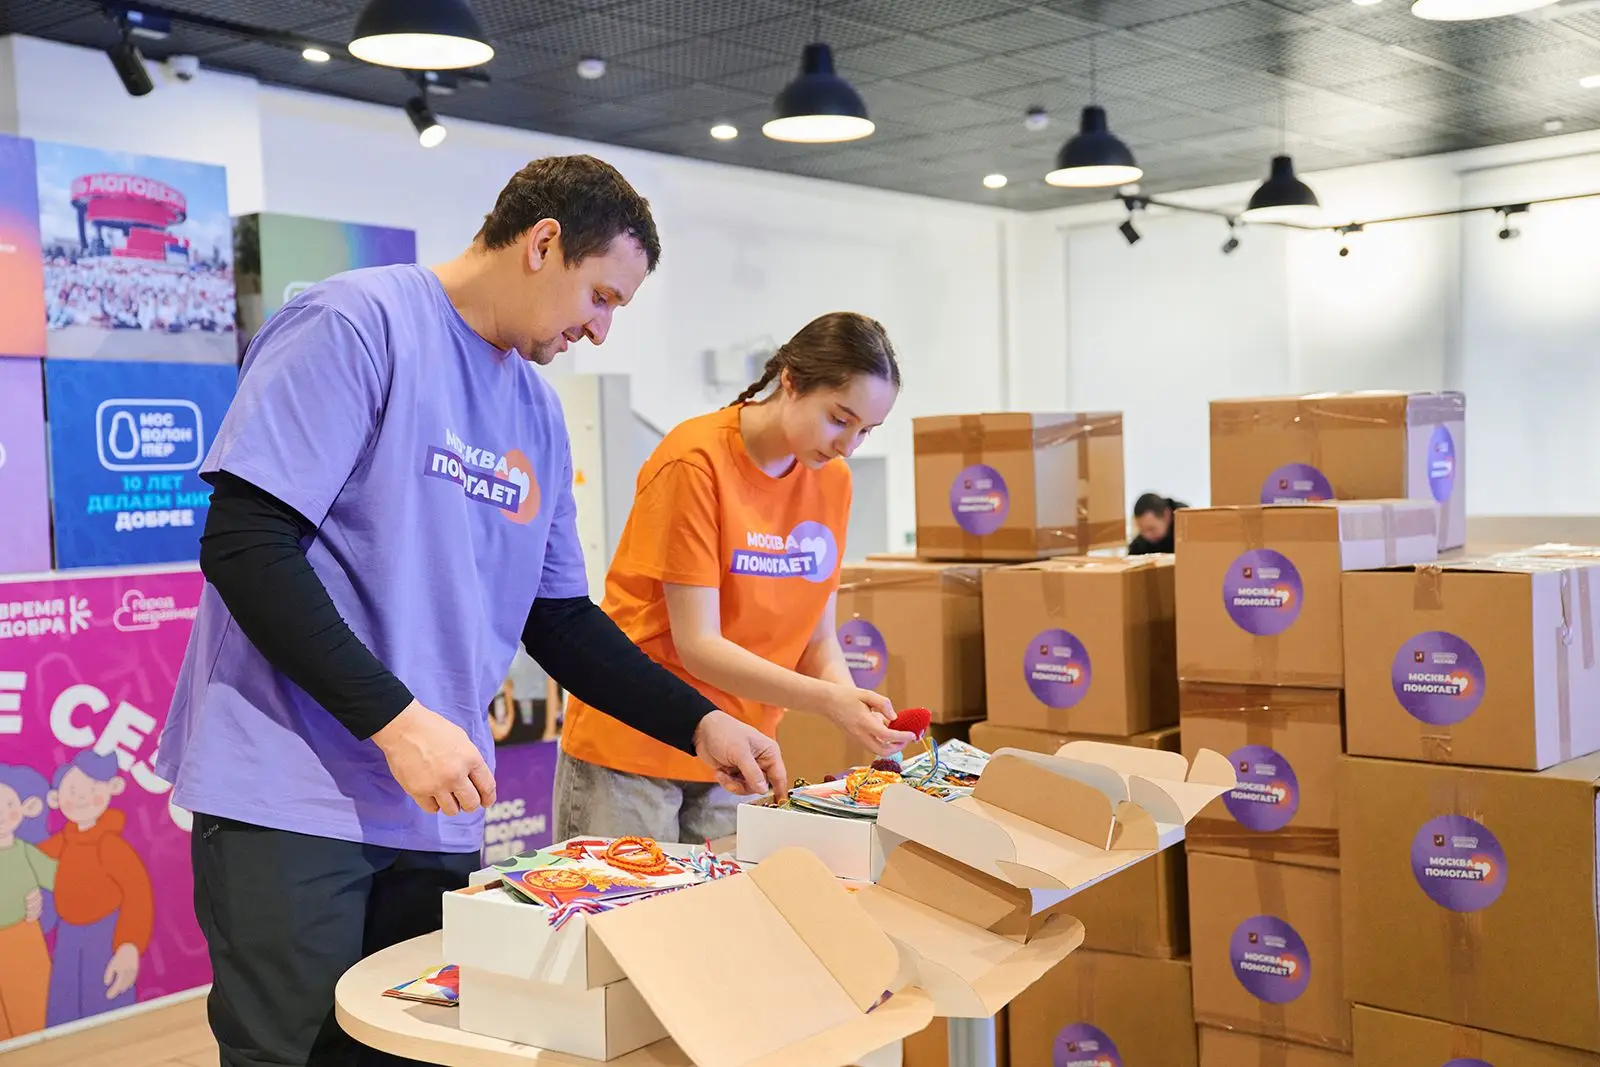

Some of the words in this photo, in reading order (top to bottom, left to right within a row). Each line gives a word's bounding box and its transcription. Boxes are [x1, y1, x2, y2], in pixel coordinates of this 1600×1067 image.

[140, 412, 174, 427] МОС
[141, 427, 192, 442] ВОЛОН
[122, 475, 143, 491] 10
[147, 474, 184, 491] ЛЕТ
[87, 493, 171, 514] ДЕЛАЕМ
[115, 509, 195, 532] ДОБРЕЕ
[746, 531, 799, 550] МОСКВА
[735, 554, 813, 574] ПОМОГАЕТ
[1238, 588, 1275, 596] МОСКВА
[1233, 597, 1281, 606] ПОМОГАЕТ
[1408, 673, 1452, 682] МОСКВА
[1403, 683, 1458, 694] ПОМОГАЕТ
[1230, 790, 1277, 803] ПОМОГАЕТ
[1429, 856, 1474, 868] МОСКВА
[1425, 867, 1481, 879] ПОМОГАЕТ
[1244, 951, 1283, 965] МОСКВА
[1240, 961, 1288, 976] ПОМОГАЕТ
